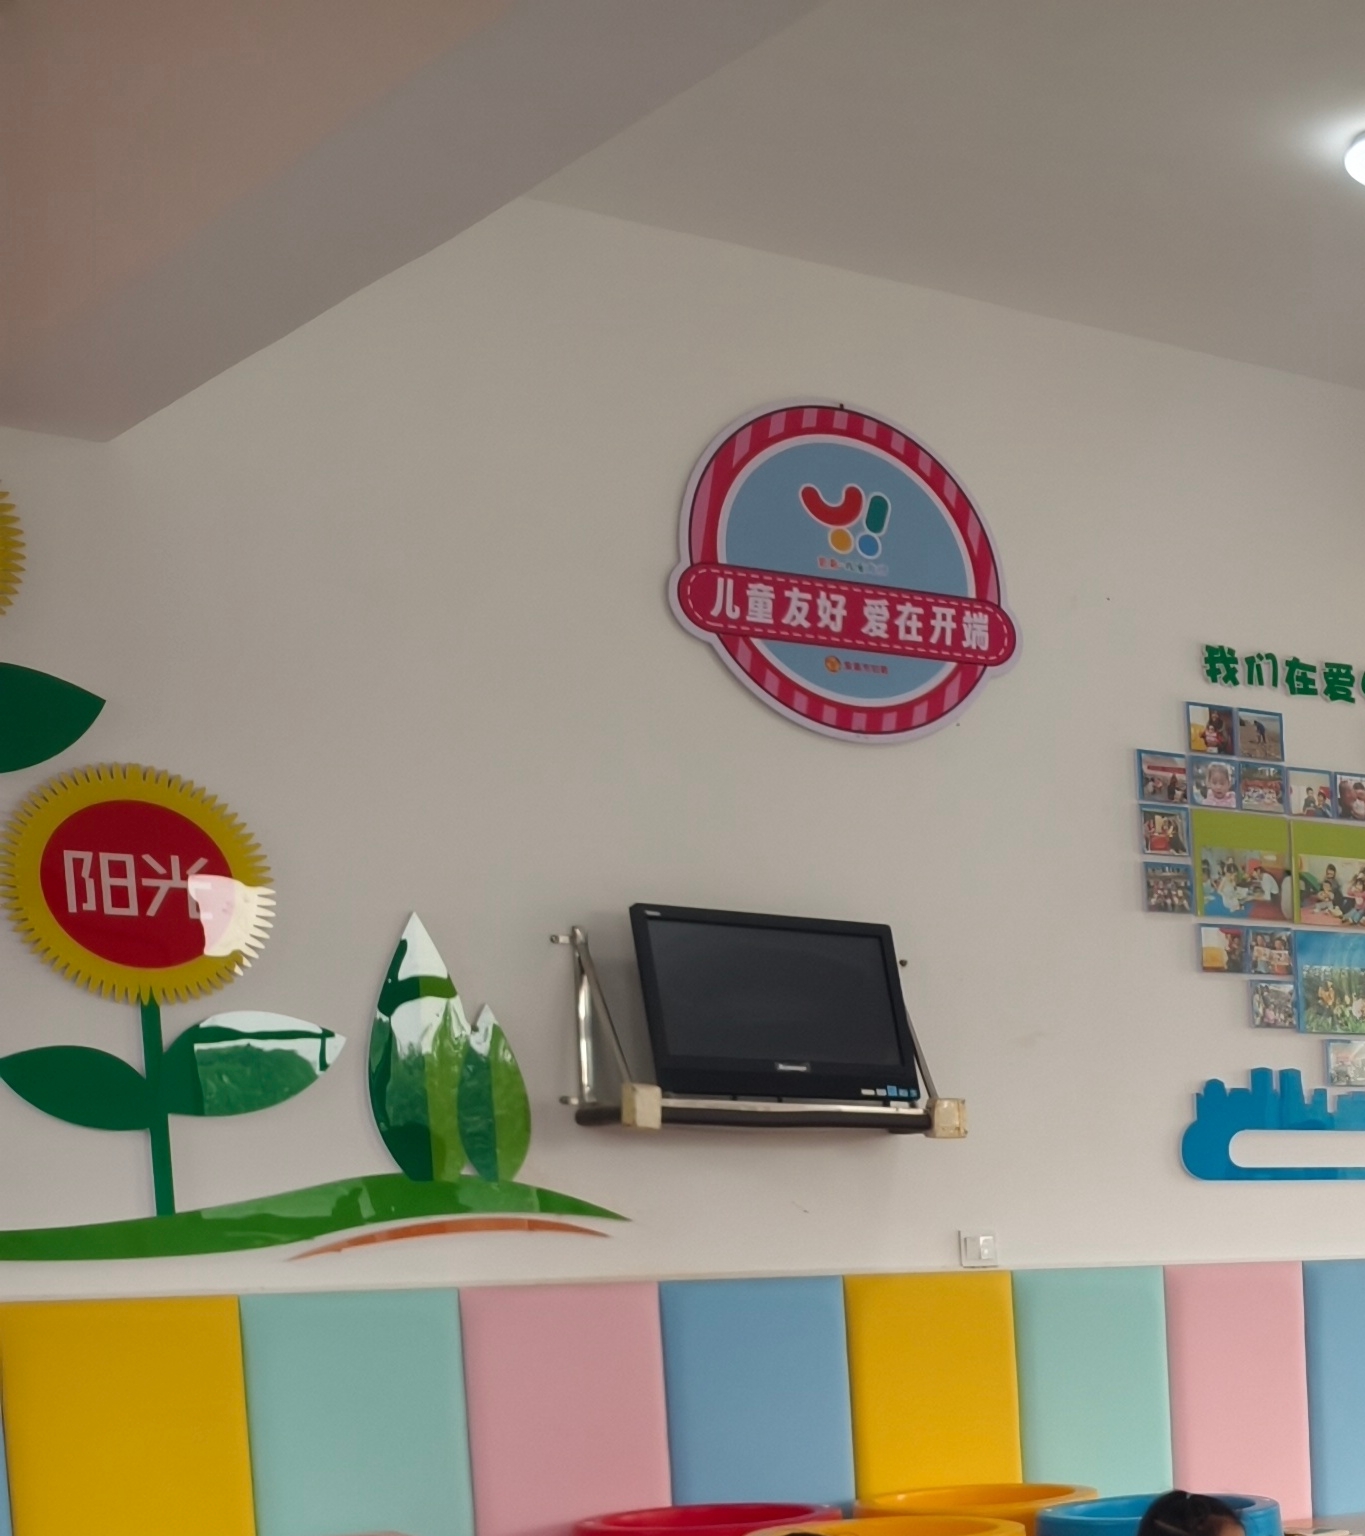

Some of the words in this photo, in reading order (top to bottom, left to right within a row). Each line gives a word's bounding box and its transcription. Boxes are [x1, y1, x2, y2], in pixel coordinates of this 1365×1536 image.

[710, 578, 848, 633] 儿童友好
[861, 598, 990, 651] 爱在开端
[64, 850, 213, 920] 阳光
